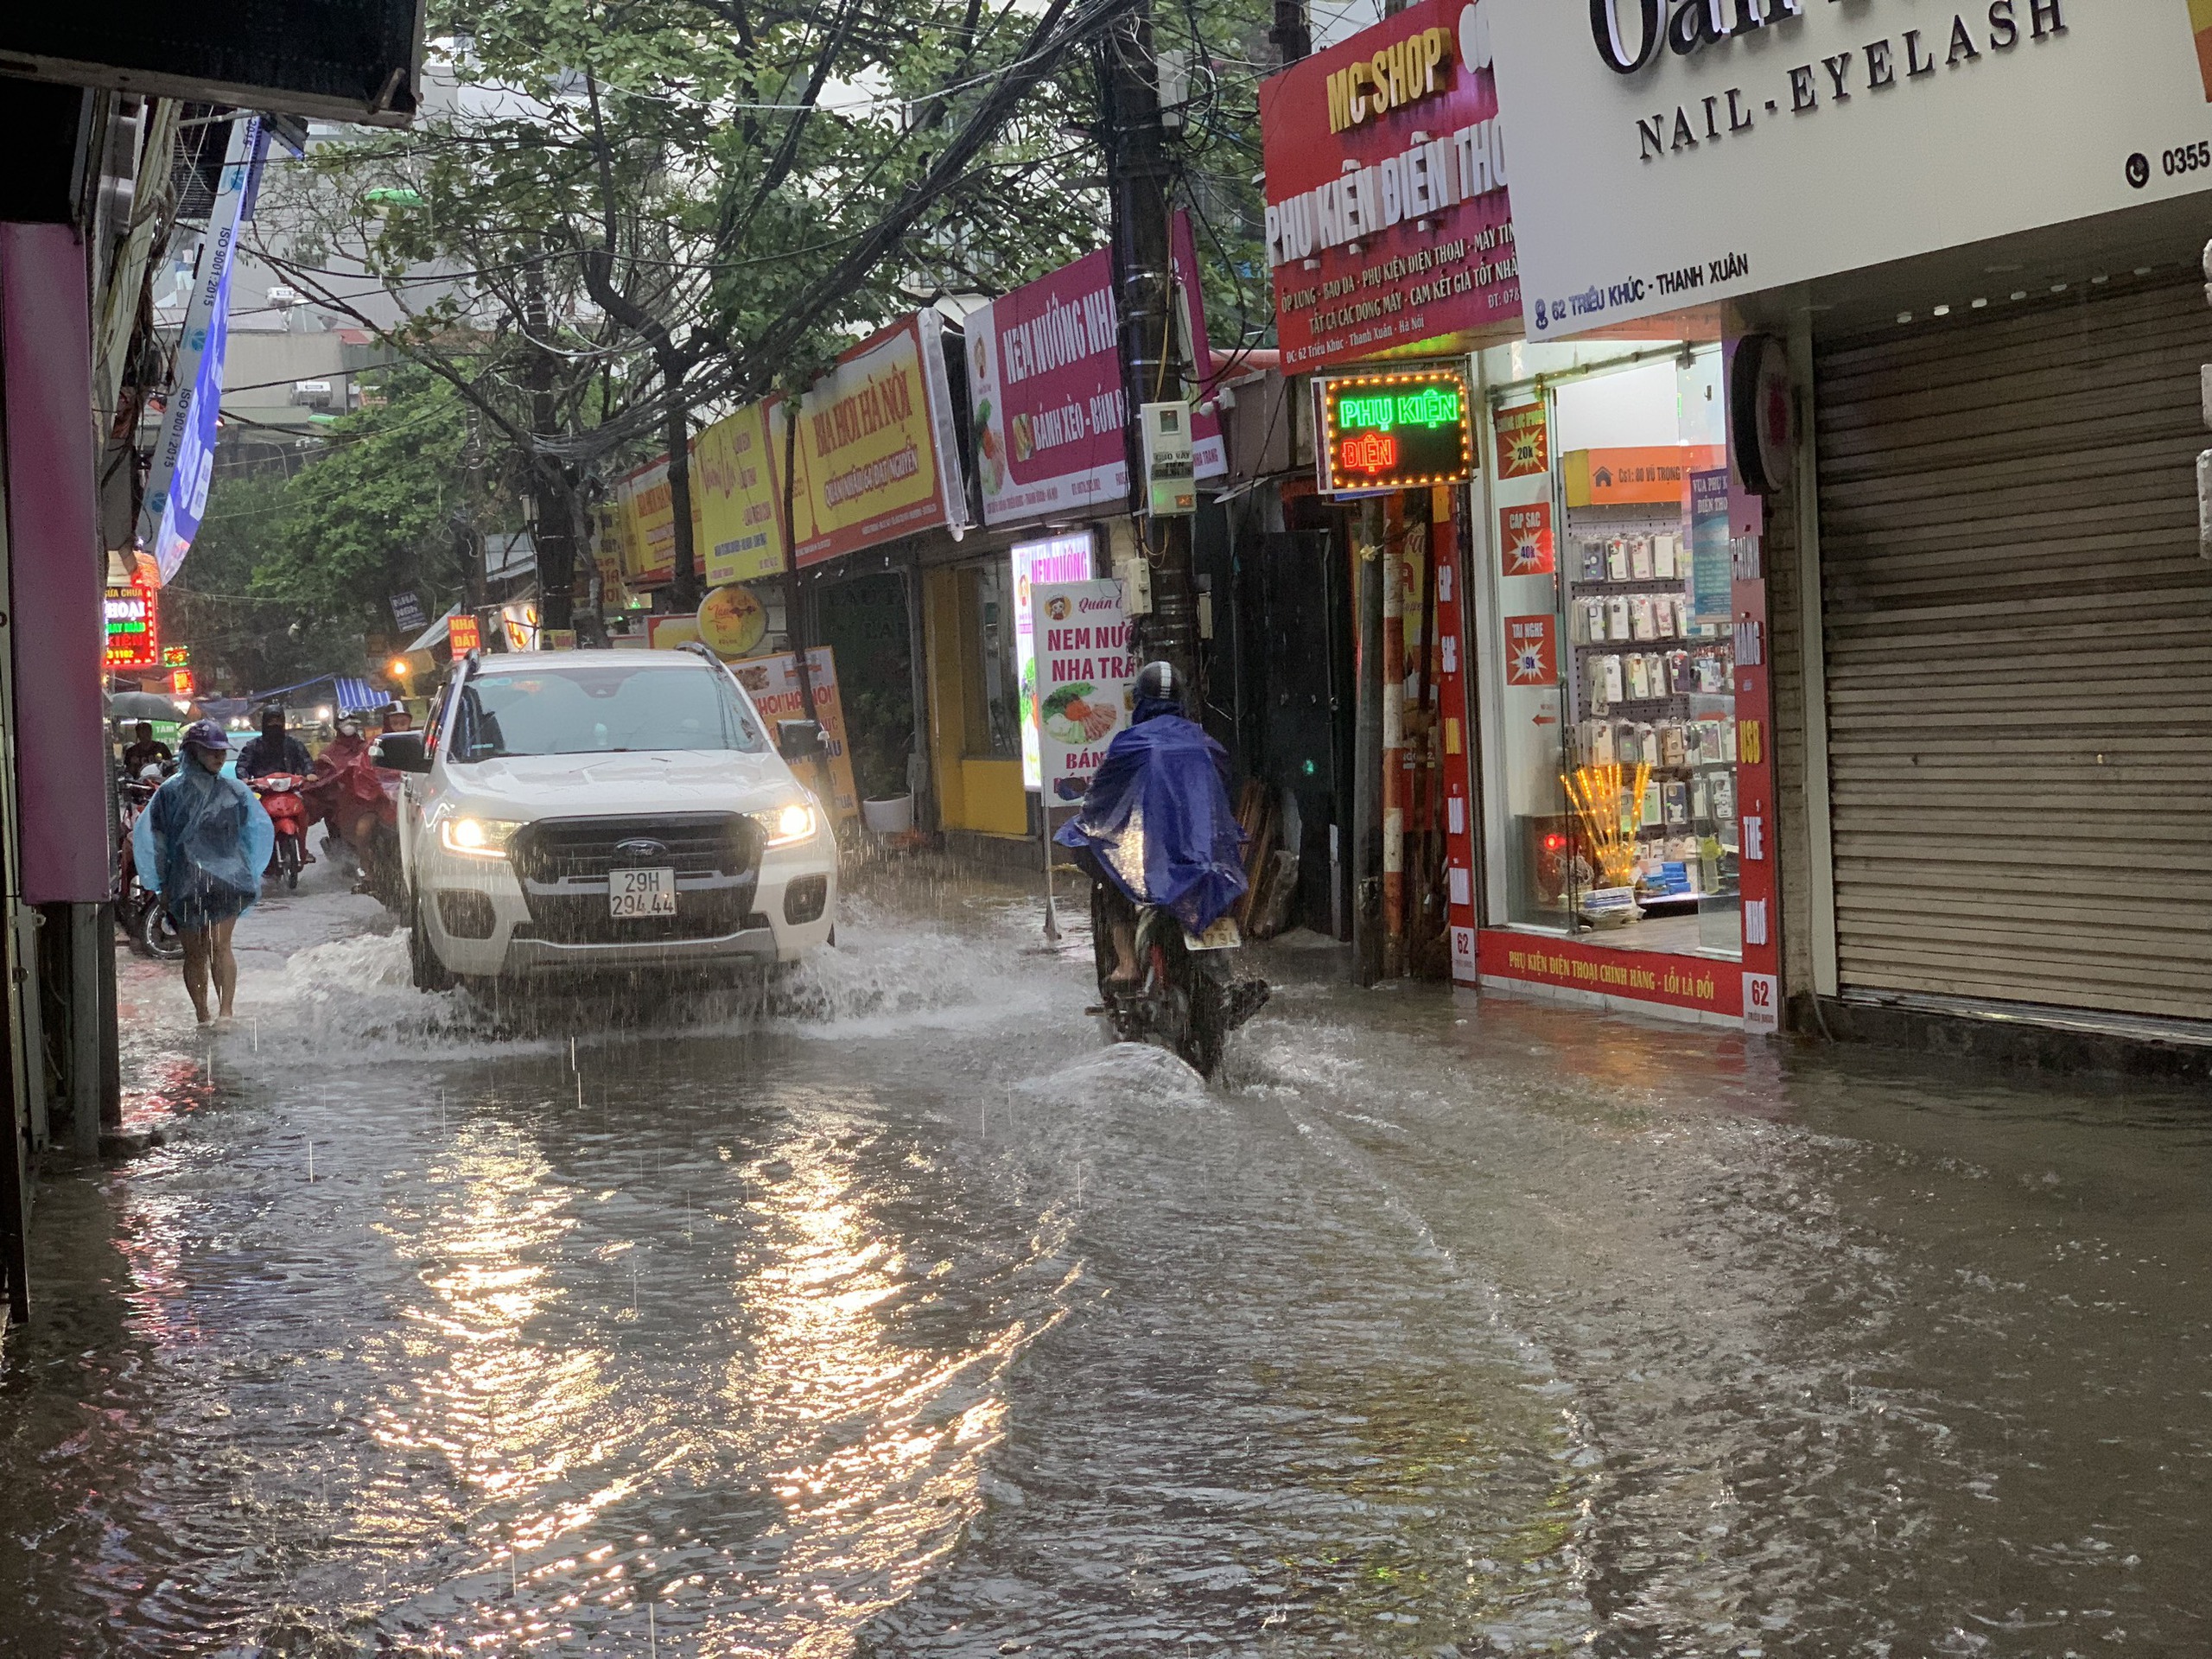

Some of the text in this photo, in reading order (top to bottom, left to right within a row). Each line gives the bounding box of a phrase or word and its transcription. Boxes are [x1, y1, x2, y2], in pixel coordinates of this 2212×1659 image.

[1326, 27, 1445, 135] MC SHOP
[1636, 88, 1753, 160] NAIL
[1787, 0, 2068, 113] EYELASH
[1265, 190, 1314, 270] PHỤ
[1316, 158, 1377, 255] KIỆN
[218, 226, 232, 247] ISO
[1323, 280, 1340, 300] BAO
[1433, 238, 1465, 264] THOẠI
[1410, 284, 1431, 307] CAM
[1550, 298, 1567, 323] 62
[1607, 274, 1645, 309] KHÚC
[1656, 264, 1704, 296] THANH
[1708, 251, 1748, 284] XUÂN
[1002, 321, 1035, 385] NEM
[1298, 347, 1306, 361] 62
[1349, 327, 1372, 348] Thanh
[1340, 397, 1394, 432] PHỤ
[1398, 388, 1459, 429] KIỆN
[1342, 434, 1393, 473] ĐIỆN
[1048, 626, 1090, 652] NEM
[1052, 658, 1093, 682] NHA
[624, 871, 660, 893] 29H
[612, 893, 674, 916] 294.44
[1457, 932, 1469, 955] 62
[1509, 950, 1526, 974] PHỤ
[1528, 950, 1548, 976] KIỆN
[1549, 954, 1570, 981] ĐIỆN
[1571, 960, 1599, 986] THOẠI
[1600, 960, 1627, 985] CHÍNH
[1751, 979, 1770, 1007] 62
